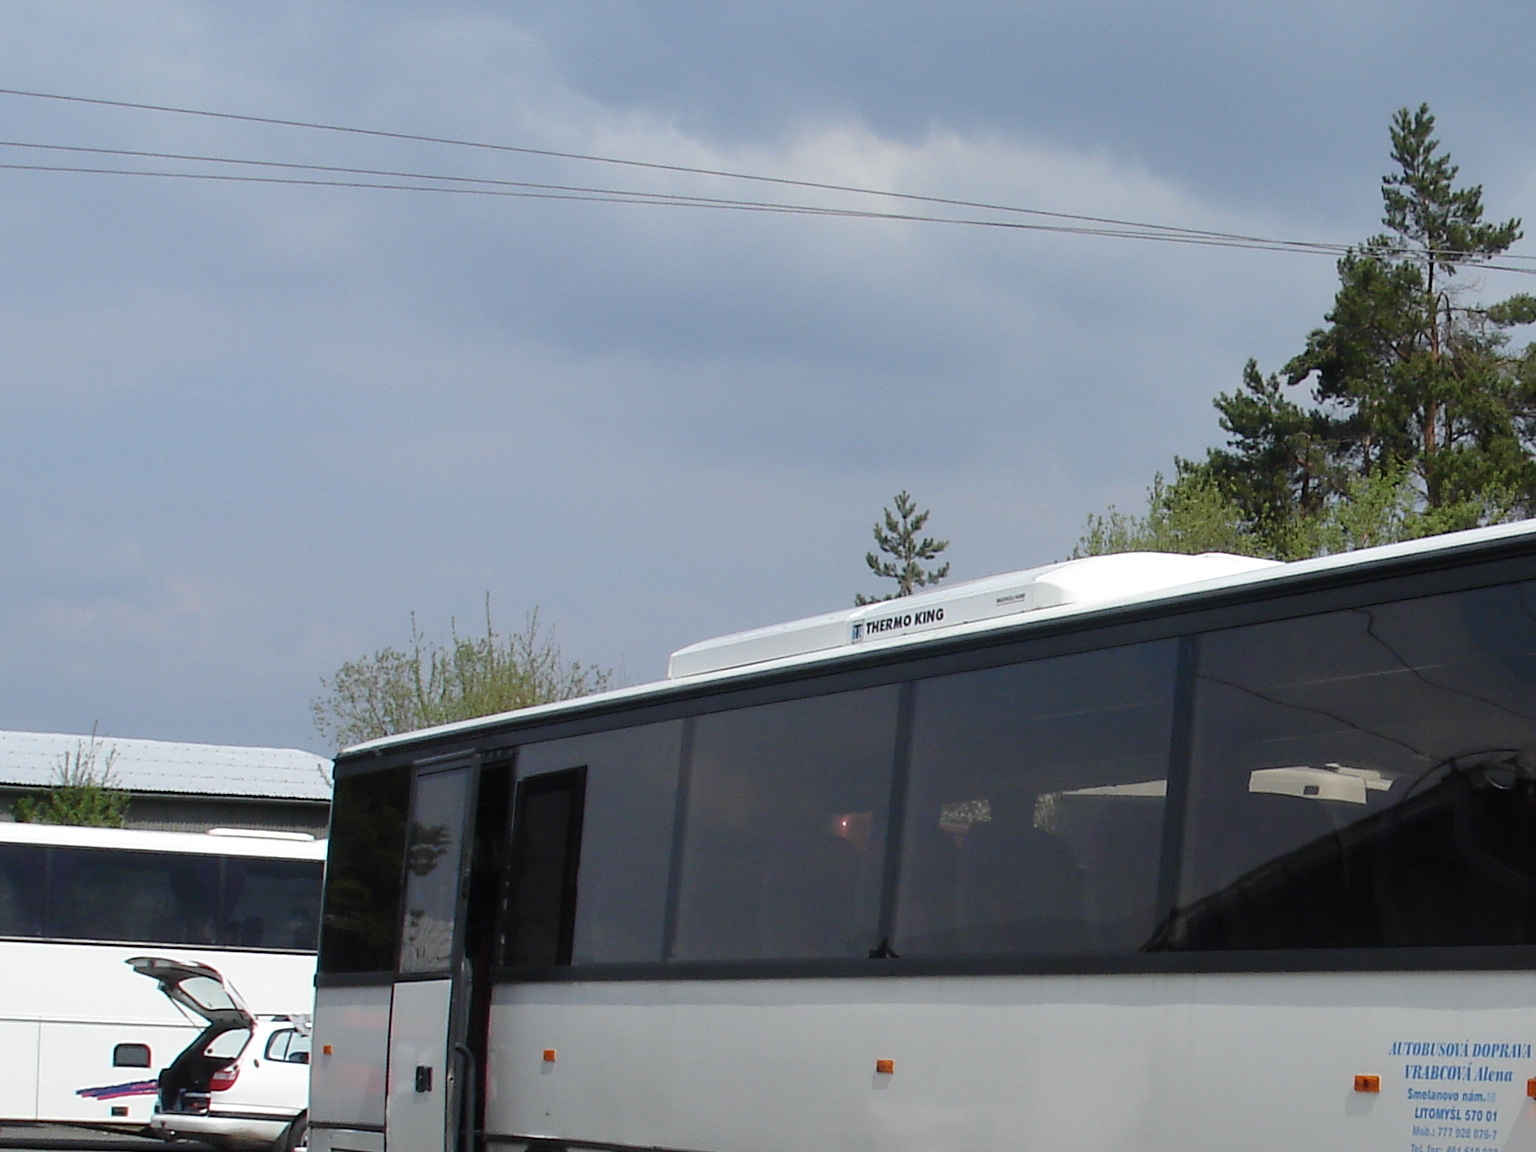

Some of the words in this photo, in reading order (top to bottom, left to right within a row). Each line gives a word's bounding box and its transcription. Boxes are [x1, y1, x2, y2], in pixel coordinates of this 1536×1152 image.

[866, 615, 912, 634] THERMO
[914, 608, 944, 626] KING
[1388, 1039, 1470, 1057] AUTOBUSOVÁ
[1472, 1043, 1532, 1058] DOPRAVA
[1404, 1062, 1473, 1081] VRABCOVÁ
[1474, 1066, 1513, 1082] Alena
[1407, 1088, 1460, 1102] Smetanovo
[1462, 1090, 1486, 1102] nám.
[1414, 1105, 1462, 1121] LITOMYŠL
[1464, 1109, 1483, 1122] 570
[1486, 1110, 1498, 1122] 01
[1438, 1126, 1453, 1138] 777
